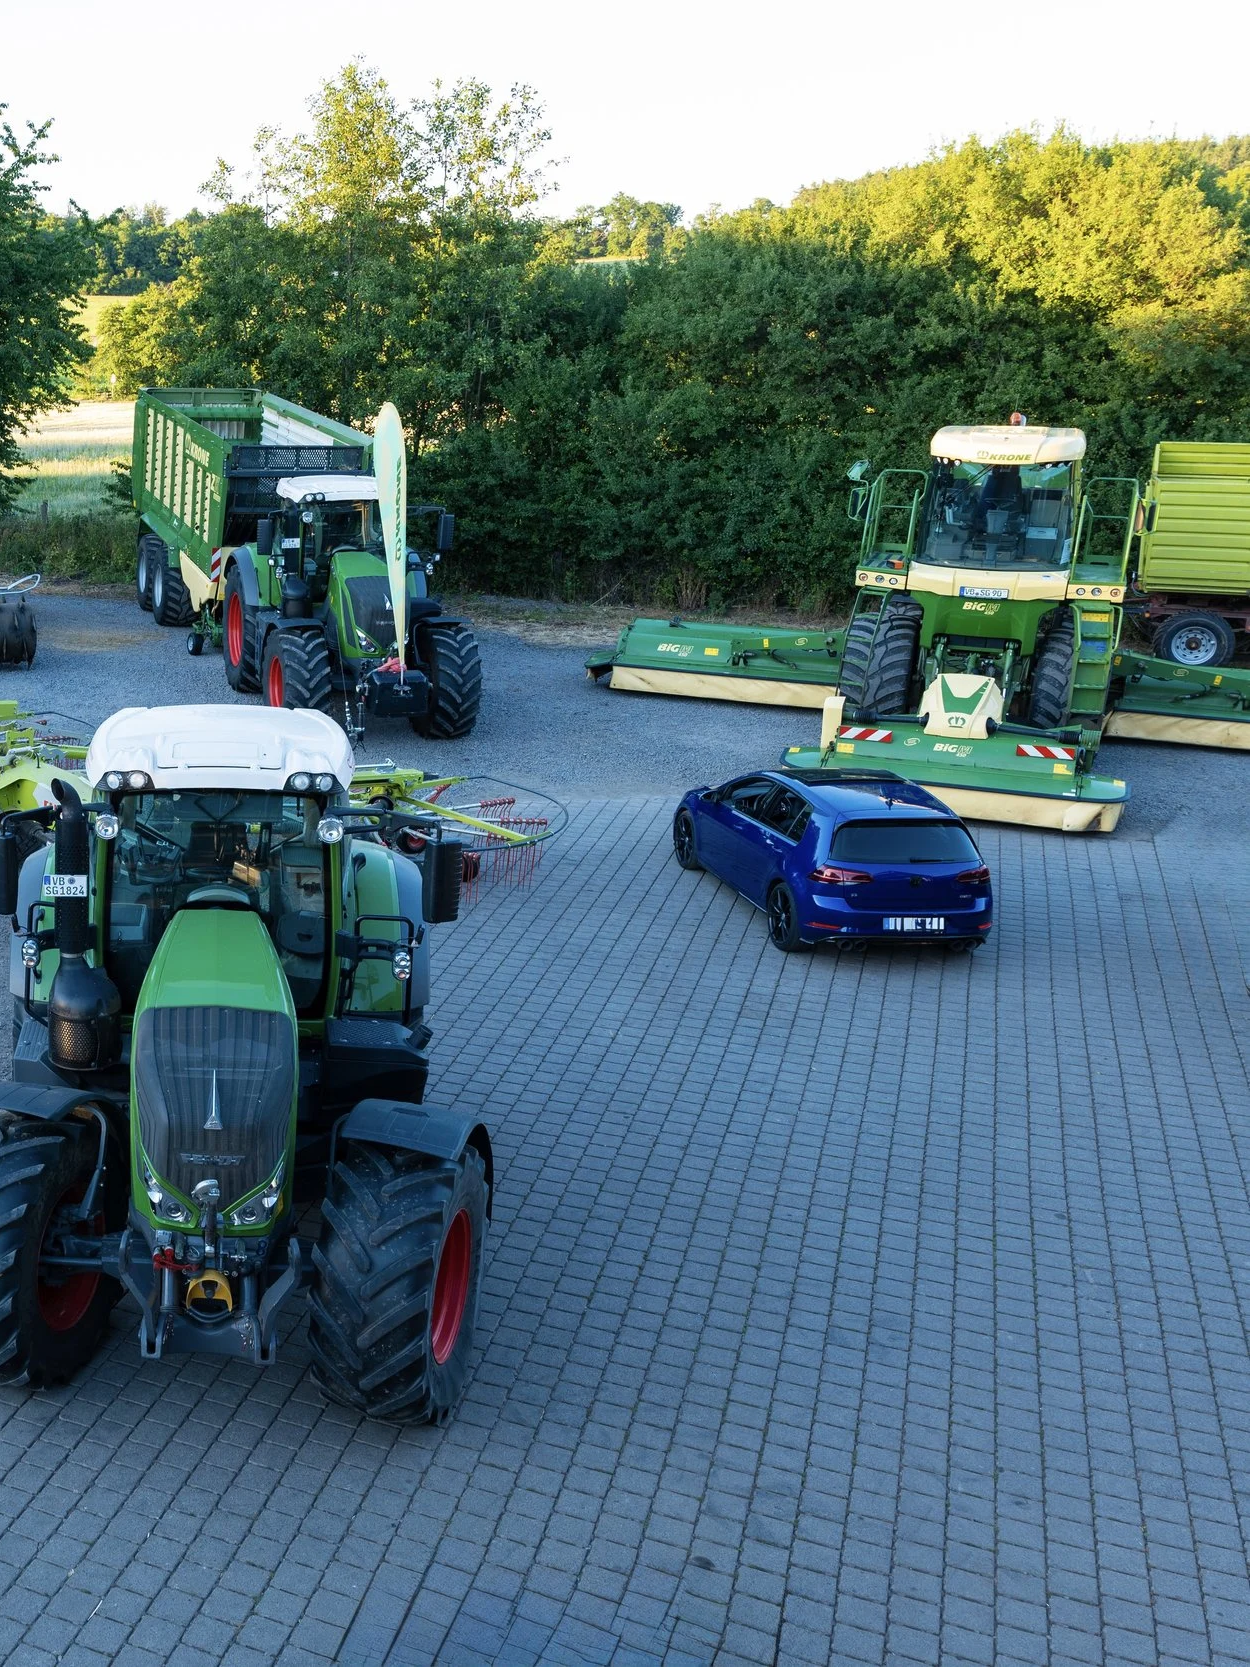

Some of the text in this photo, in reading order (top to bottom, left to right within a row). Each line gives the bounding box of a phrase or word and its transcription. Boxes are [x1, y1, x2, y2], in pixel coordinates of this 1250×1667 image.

[989, 453, 1032, 461] KRONE
[979, 589, 991, 597] SG
[52, 876, 66, 886] VB
[45, 886, 85, 896] SG1824
[180, 1153, 246, 1165] FENDT
